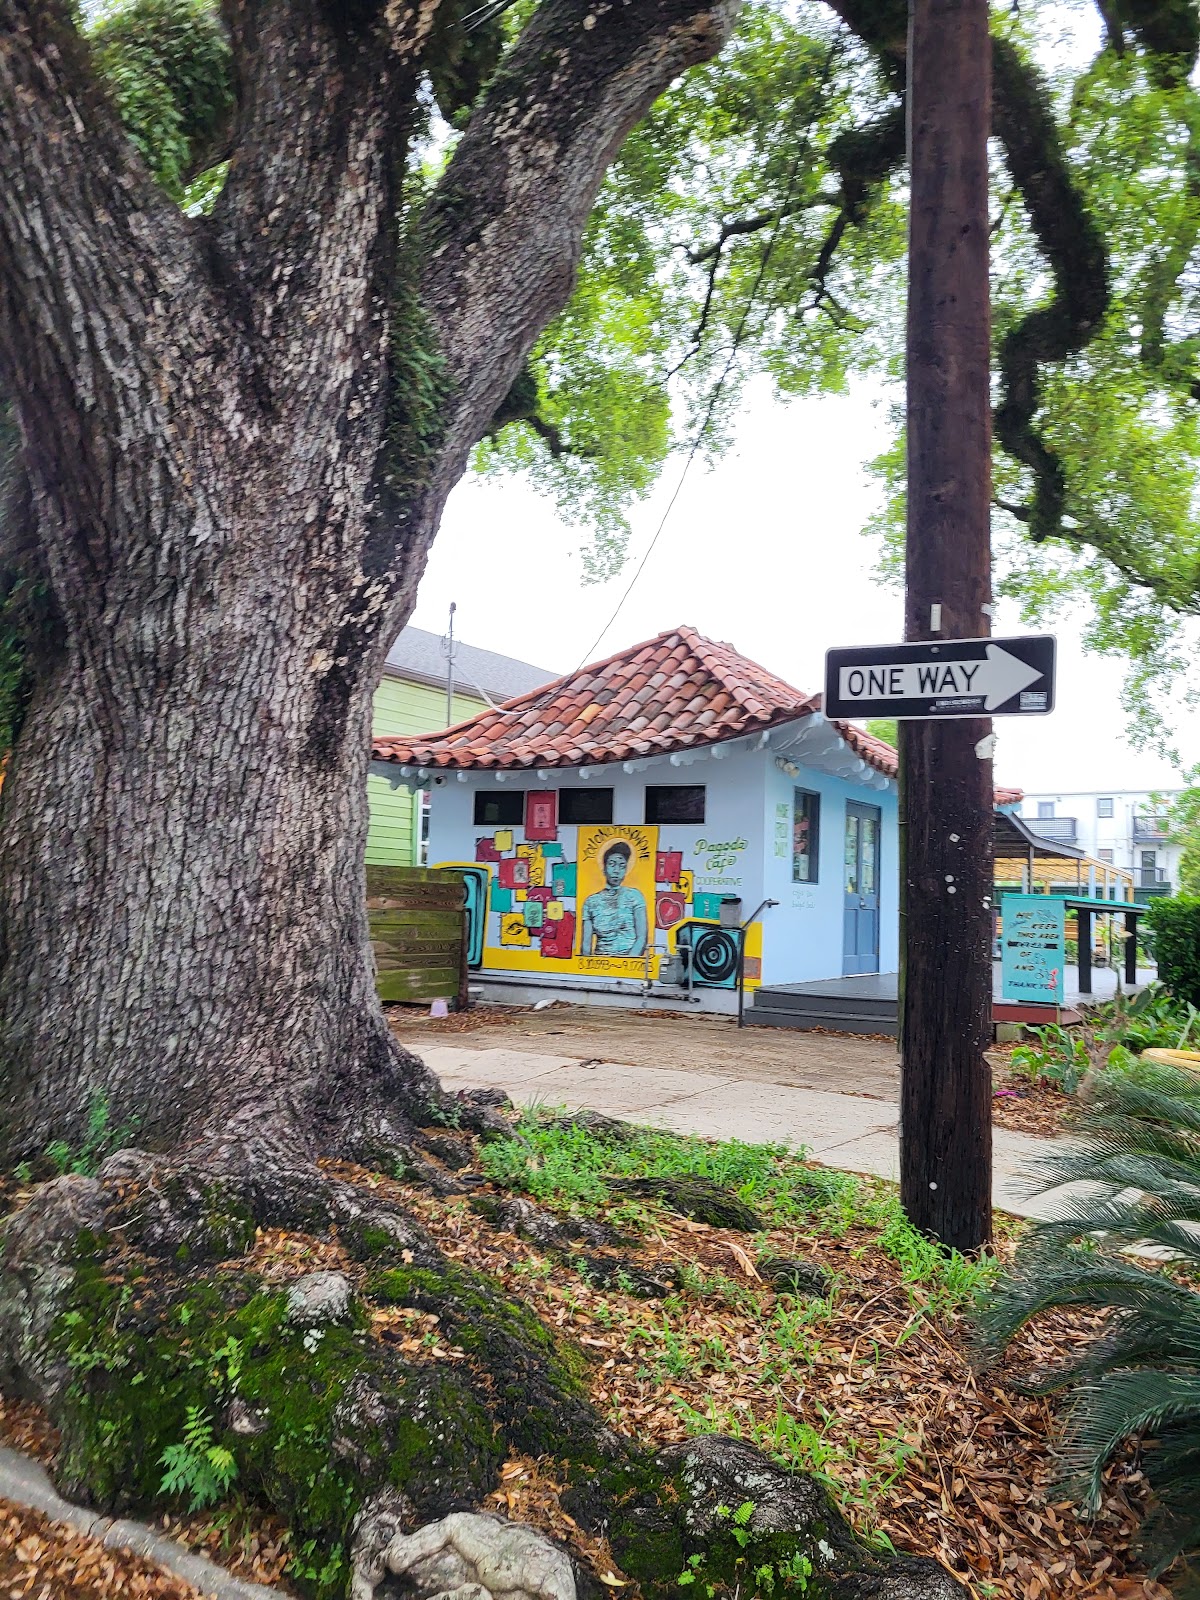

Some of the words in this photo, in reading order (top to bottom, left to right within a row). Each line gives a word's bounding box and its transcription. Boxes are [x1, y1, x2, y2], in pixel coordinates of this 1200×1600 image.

[848, 668, 905, 697] ONE
[917, 664, 980, 694] WAY
[693, 836, 748, 859] Pagoda
[1008, 981, 1037, 989] THANK
